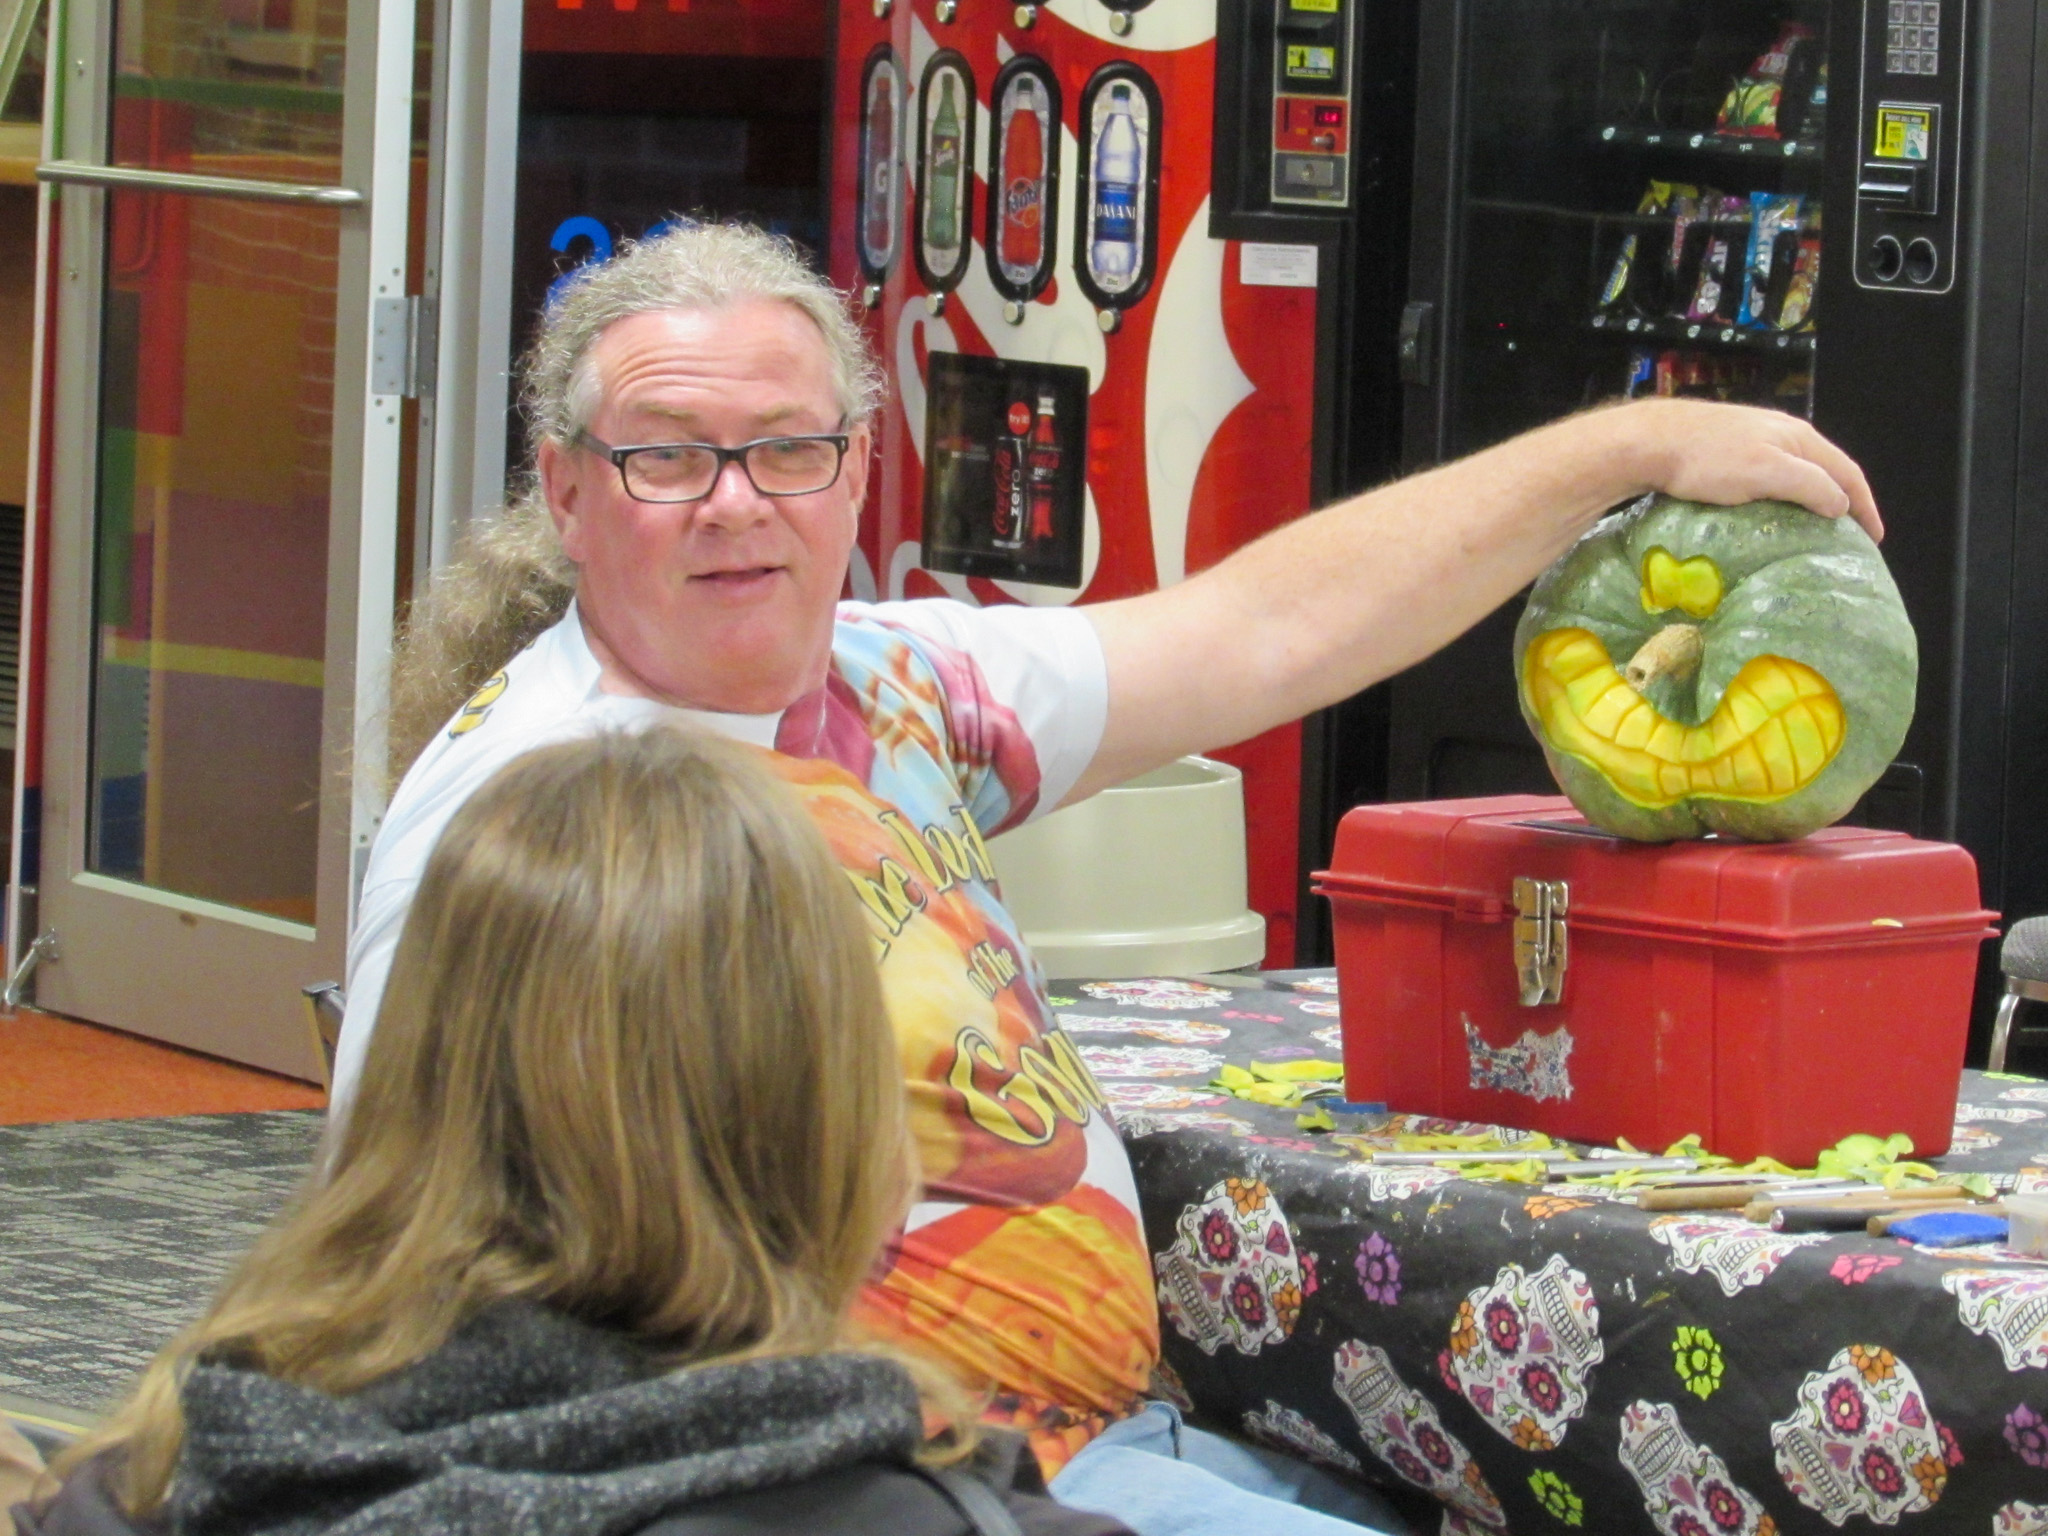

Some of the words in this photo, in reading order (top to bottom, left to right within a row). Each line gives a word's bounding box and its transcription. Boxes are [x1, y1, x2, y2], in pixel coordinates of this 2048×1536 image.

[1096, 203, 1136, 220] DASANI
[1009, 413, 1021, 425] try
[1011, 468, 1021, 517] zero
[878, 805, 996, 894] Lord
[842, 857, 928, 962] he
[967, 948, 998, 1001] of
